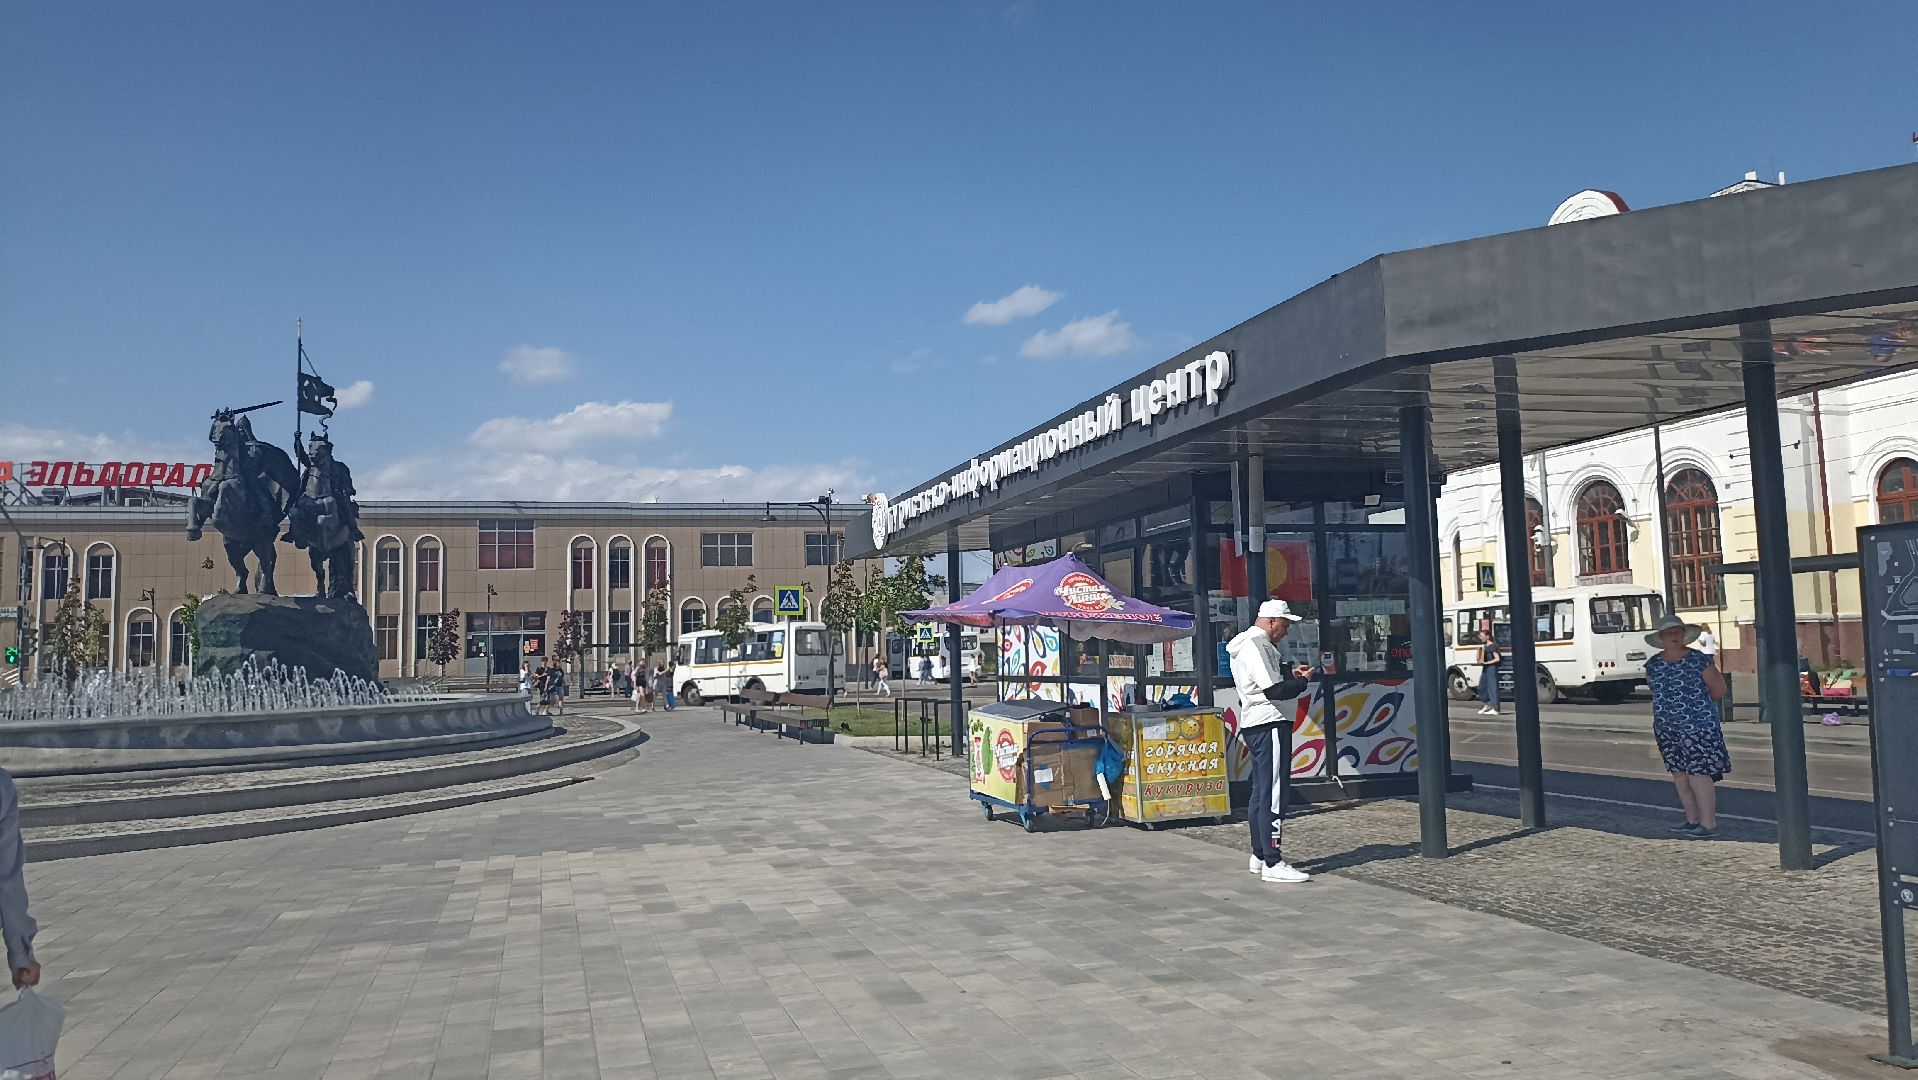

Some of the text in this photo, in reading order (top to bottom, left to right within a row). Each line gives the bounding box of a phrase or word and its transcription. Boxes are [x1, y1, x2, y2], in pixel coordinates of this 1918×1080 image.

[1131, 350, 1230, 426] центр
[22, 461, 213, 488] ЭЛЬДОРАД
[1145, 741, 1219, 759] горячая
[1146, 757, 1219, 776] вкусная
[1271, 818, 1281, 849] FILA
